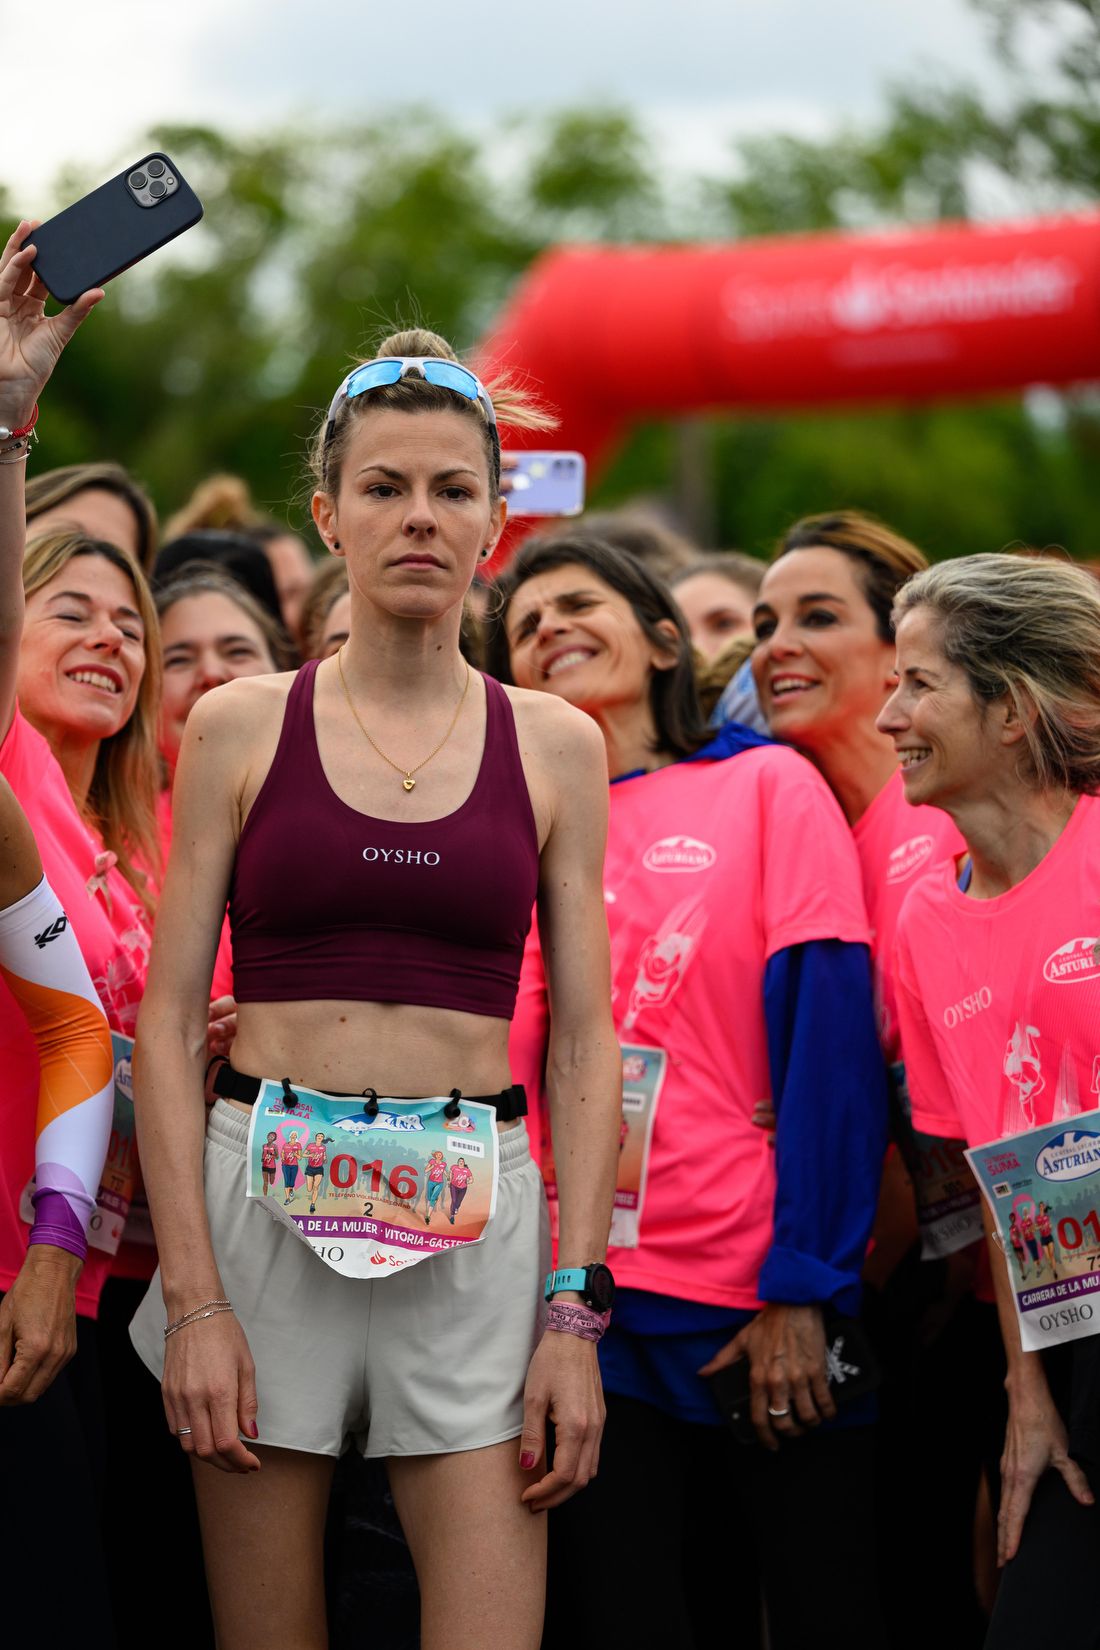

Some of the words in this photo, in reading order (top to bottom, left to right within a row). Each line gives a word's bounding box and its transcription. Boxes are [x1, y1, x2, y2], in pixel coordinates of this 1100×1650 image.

[362, 847, 440, 866] OYSHO
[1050, 956, 1096, 979] ASTURI
[943, 985, 992, 1029] OYSHO
[329, 1153, 418, 1199] 016
[363, 1202, 374, 1217] 2
[308, 1221, 322, 1231] DE
[325, 1221, 339, 1232] LA
[342, 1221, 378, 1234] MUJER
[1022, 1288, 1056, 1306] CARRERA
[1056, 1284, 1067, 1297] DE
[1068, 1281, 1081, 1293] LA
[1040, 1304, 1093, 1331] OYSHO
